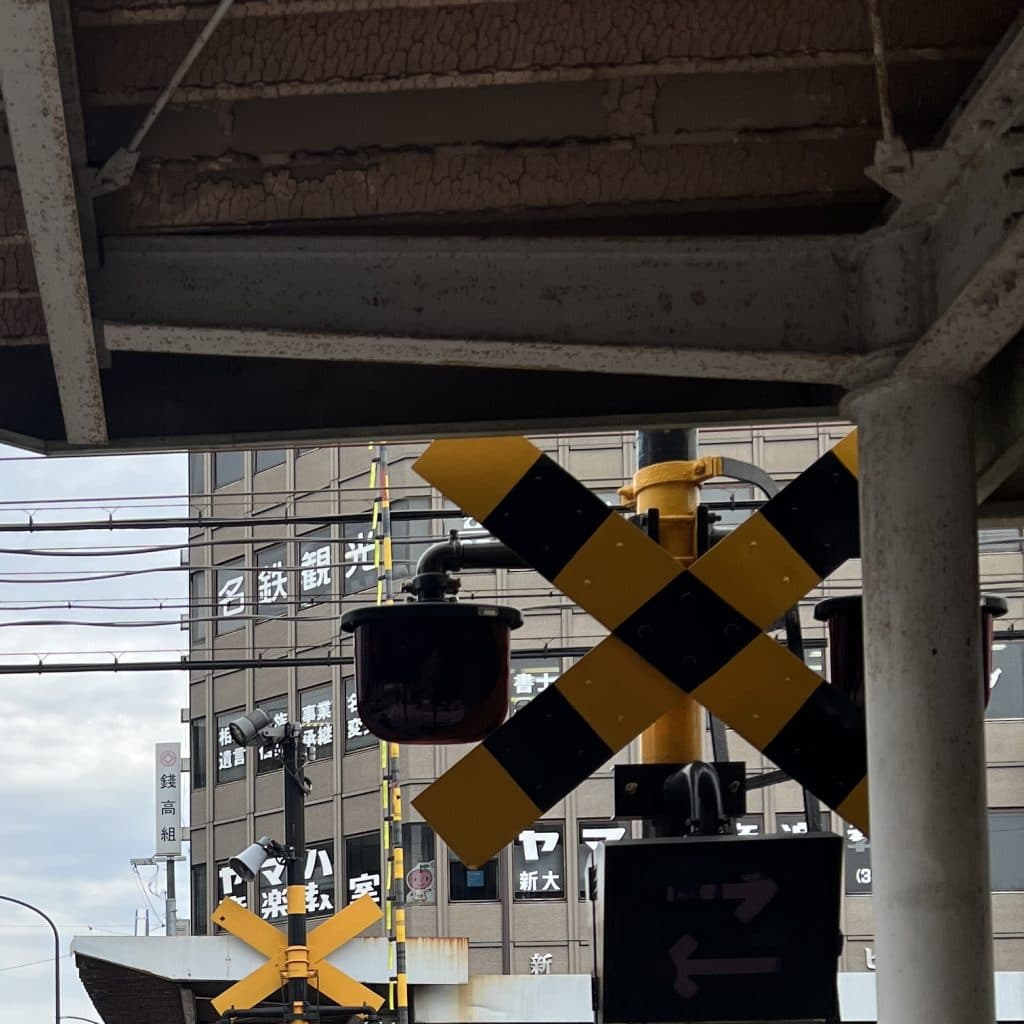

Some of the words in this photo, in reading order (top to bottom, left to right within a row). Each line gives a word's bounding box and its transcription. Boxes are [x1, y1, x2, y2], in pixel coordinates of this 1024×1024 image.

[218, 532, 377, 617] 名鉄観光
[302, 700, 332, 723] 事業
[219, 746, 247, 770] 遺言
